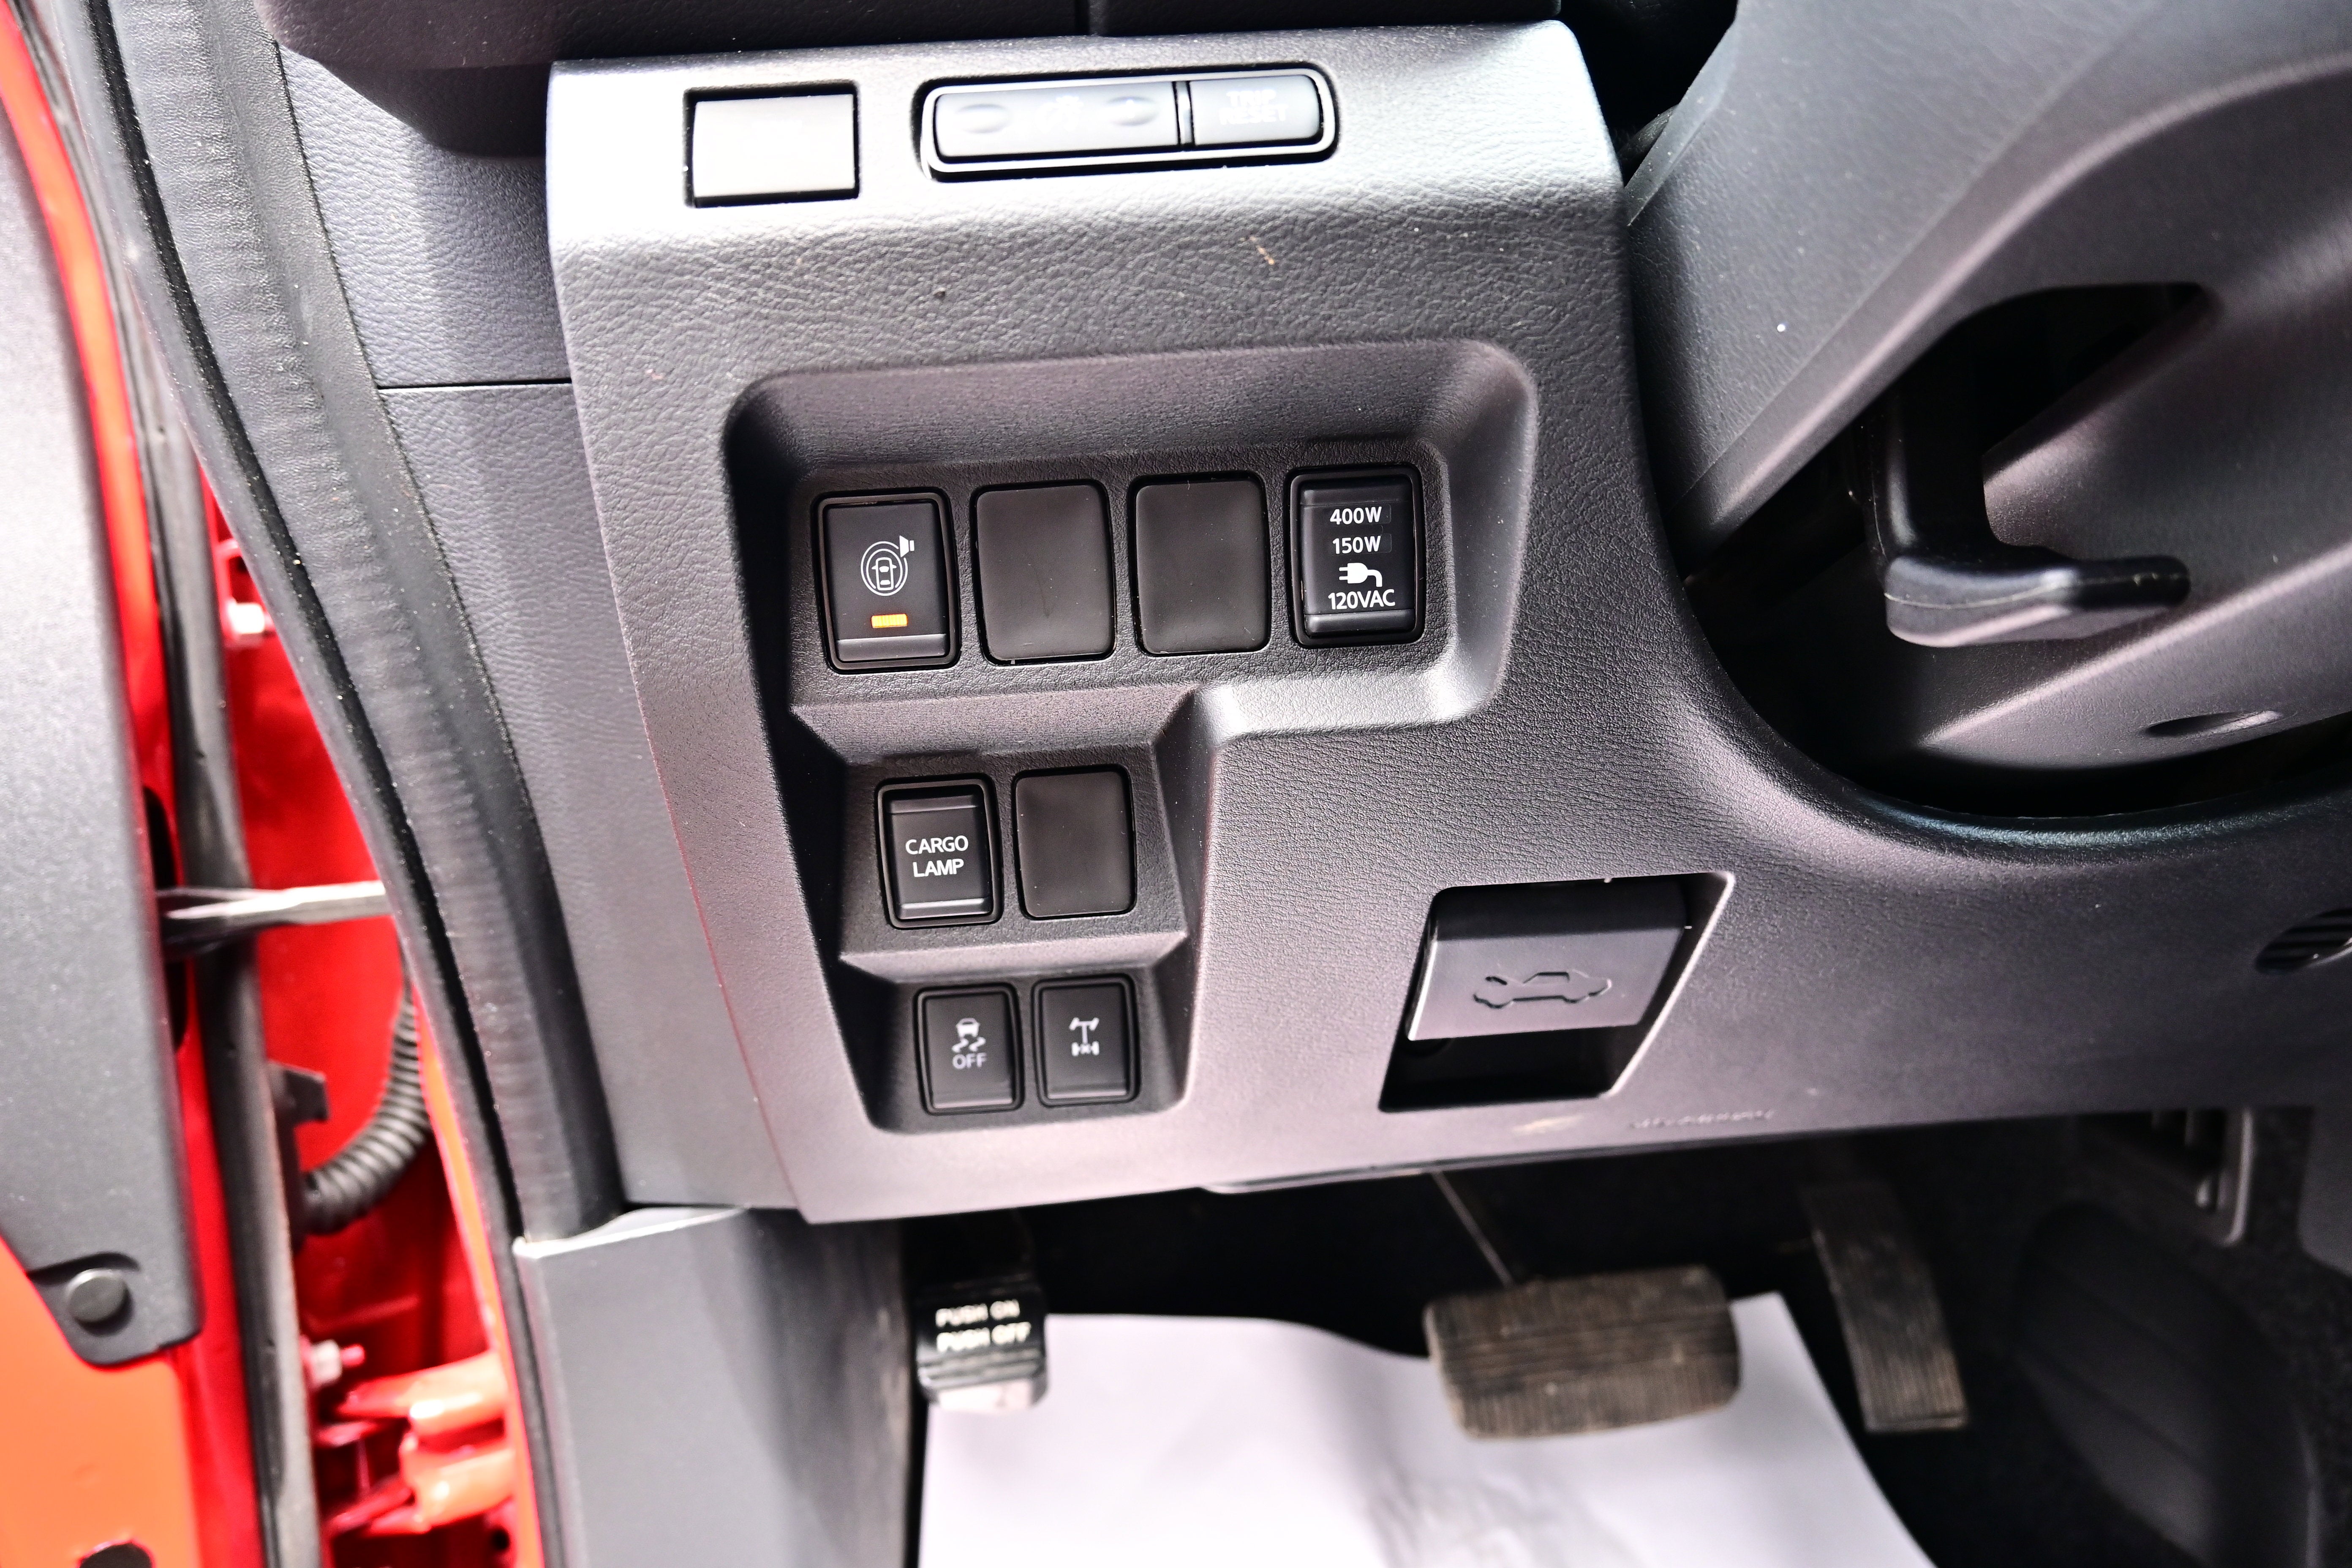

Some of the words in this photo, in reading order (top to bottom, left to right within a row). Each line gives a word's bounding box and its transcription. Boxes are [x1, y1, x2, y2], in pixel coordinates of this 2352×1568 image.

[1227, 89, 1277, 106] TRIP
[1219, 104, 1288, 125] RESET
[1330, 506, 1382, 525] 400W
[1332, 536, 1381, 554] 150W
[1328, 589, 1395, 610] 120VAC
[905, 835, 969, 855] CARGO
[913, 858, 964, 877] LAMP
[952, 1052, 987, 1070] OFF
[935, 1304, 988, 1328] PUSH
[990, 1299, 1020, 1320] ON
[936, 1327, 991, 1352] PUSH
[992, 1321, 1031, 1345] OFF
